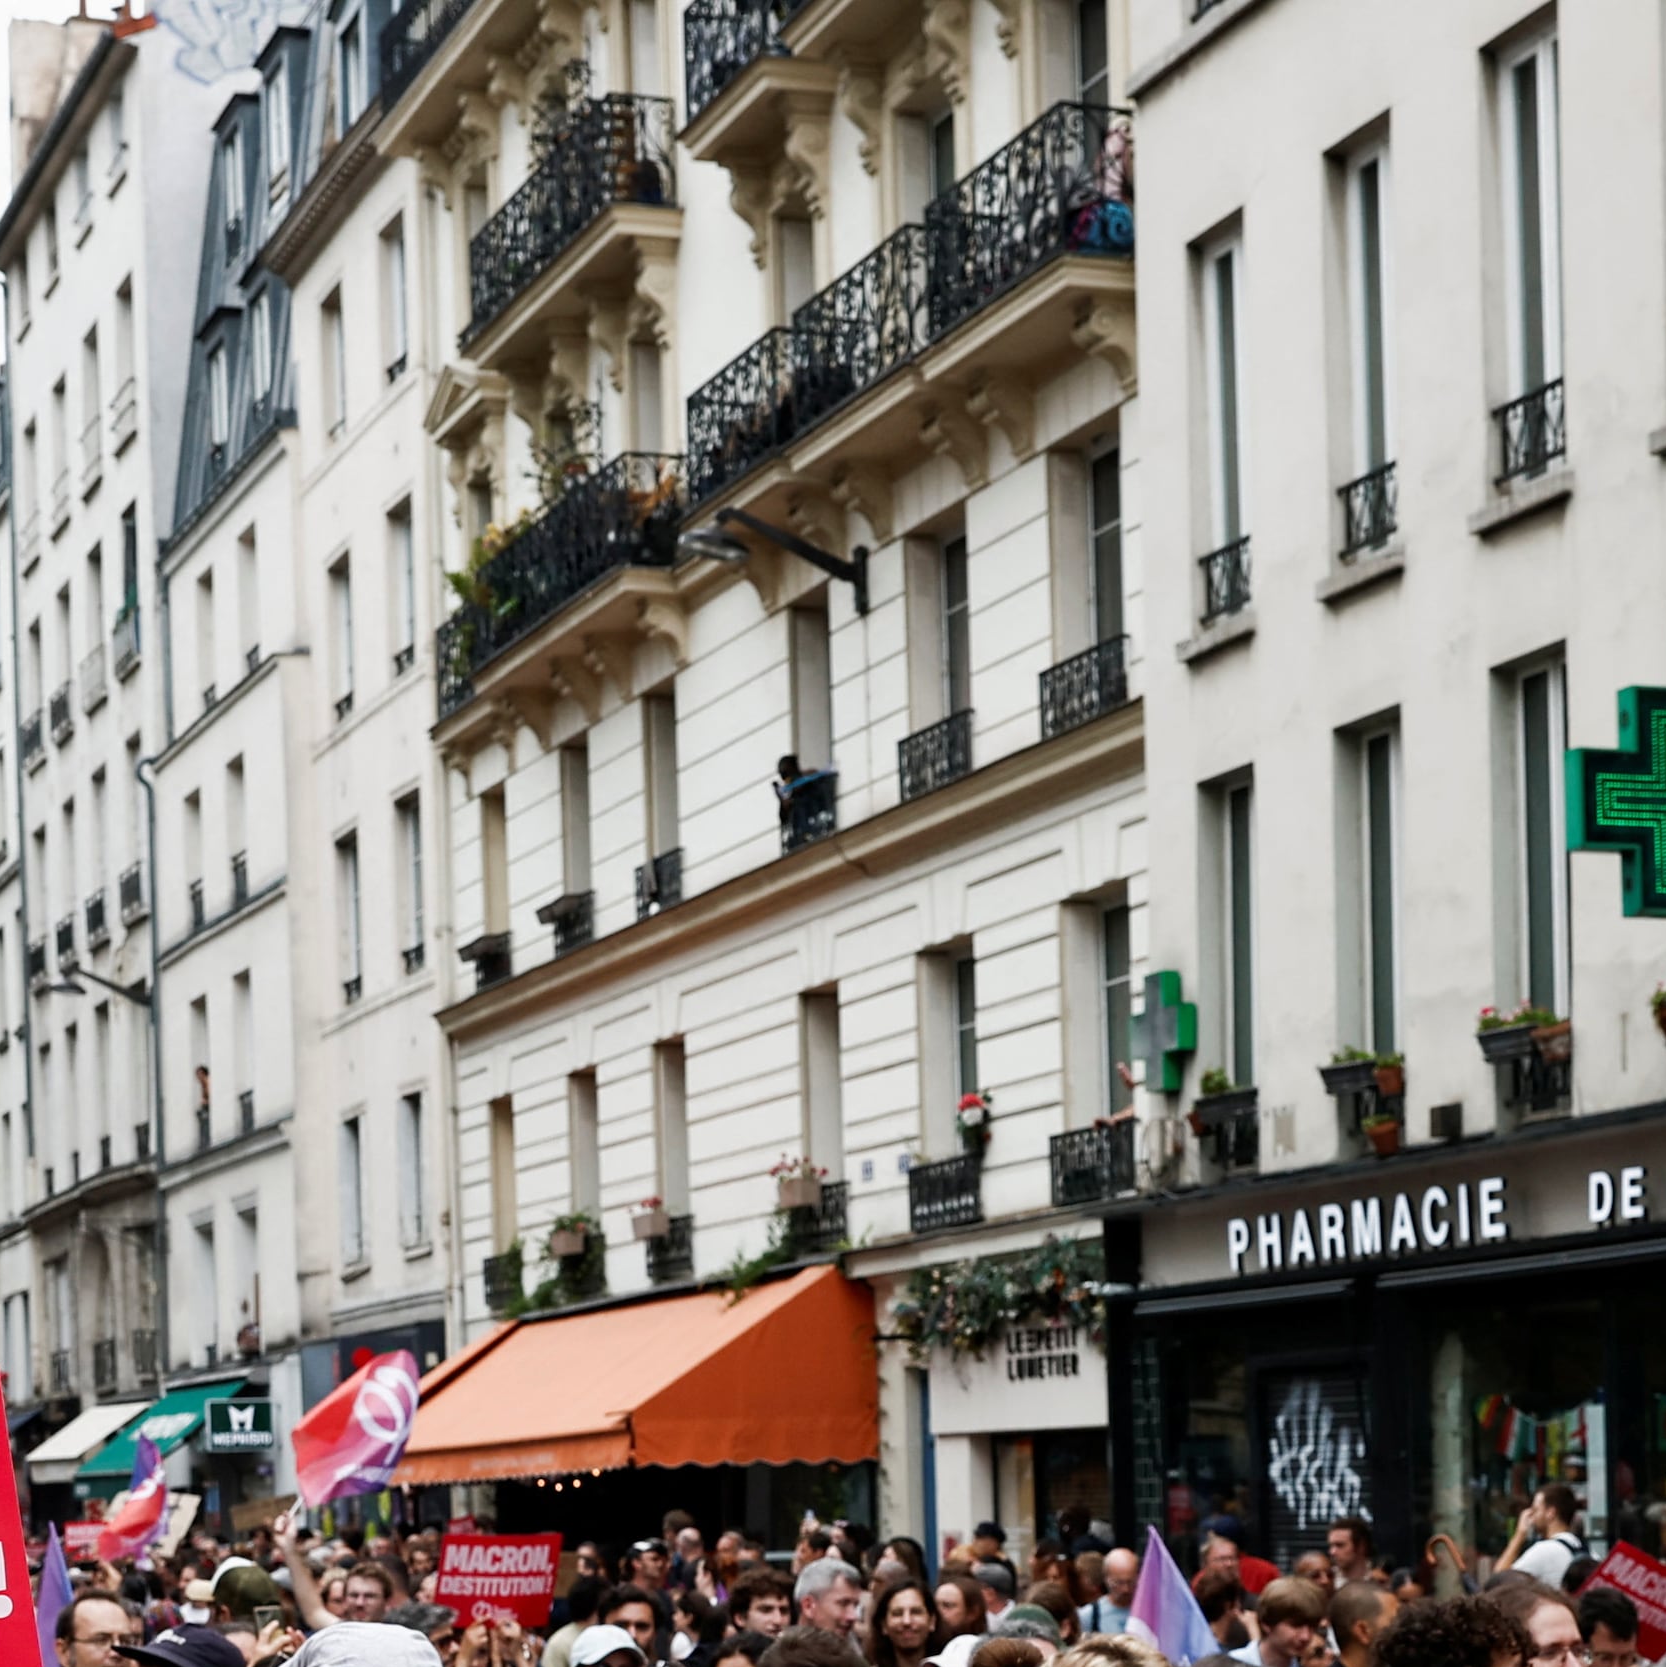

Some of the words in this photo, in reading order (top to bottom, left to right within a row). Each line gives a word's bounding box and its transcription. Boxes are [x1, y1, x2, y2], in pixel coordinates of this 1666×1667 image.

[1228, 1177, 1509, 1272] PHARMACIE
[1588, 1166, 1646, 1223] DE
[444, 1544, 554, 1575] MACRON,
